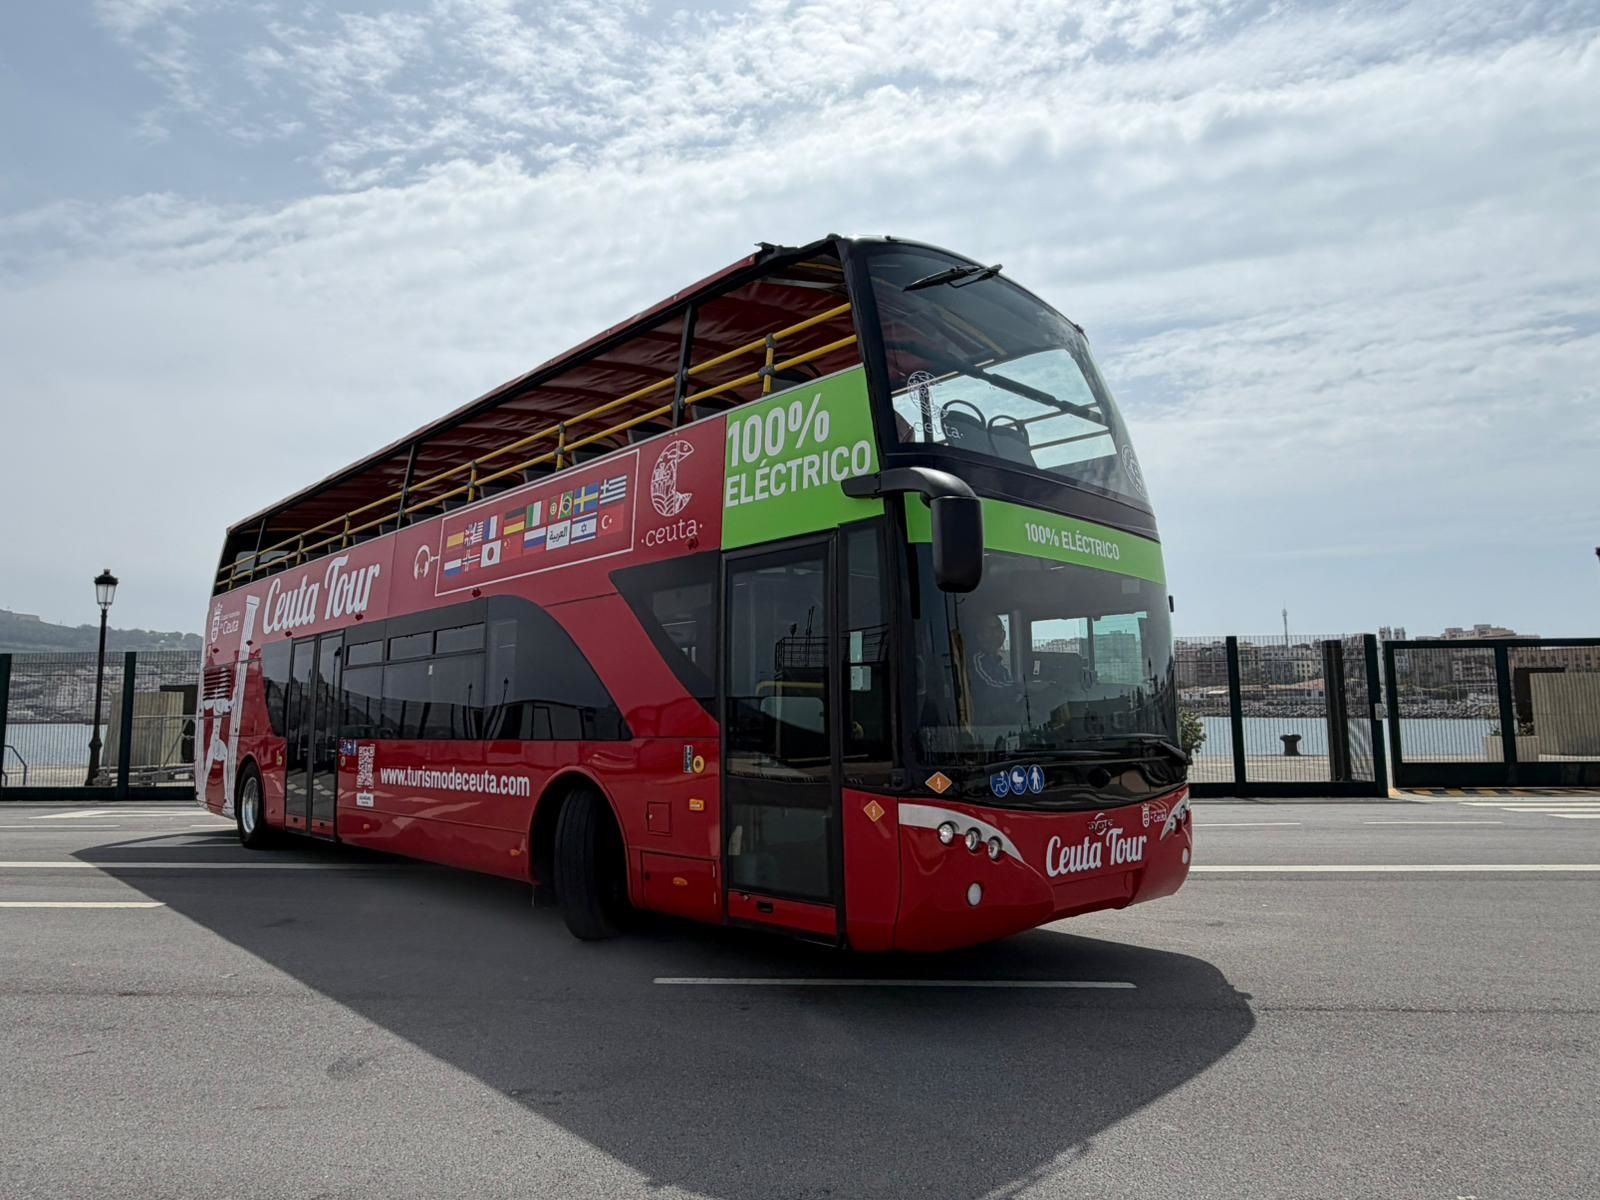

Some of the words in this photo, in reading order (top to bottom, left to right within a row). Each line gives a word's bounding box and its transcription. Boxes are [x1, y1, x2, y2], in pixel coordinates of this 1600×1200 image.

[727, 392, 830, 468] 100%
[725, 440, 871, 508] ELÉCTRICO
[1025, 522, 1060, 547] 100%
[1061, 530, 1121, 560] ELÉCTRICO
[262, 574, 320, 635] Ceuta
[324, 553, 380, 620] Tour
[380, 765, 531, 797] www.turismodeceuta.com
[1045, 835, 1102, 878] Ceuta
[1106, 827, 1148, 866] Tour
